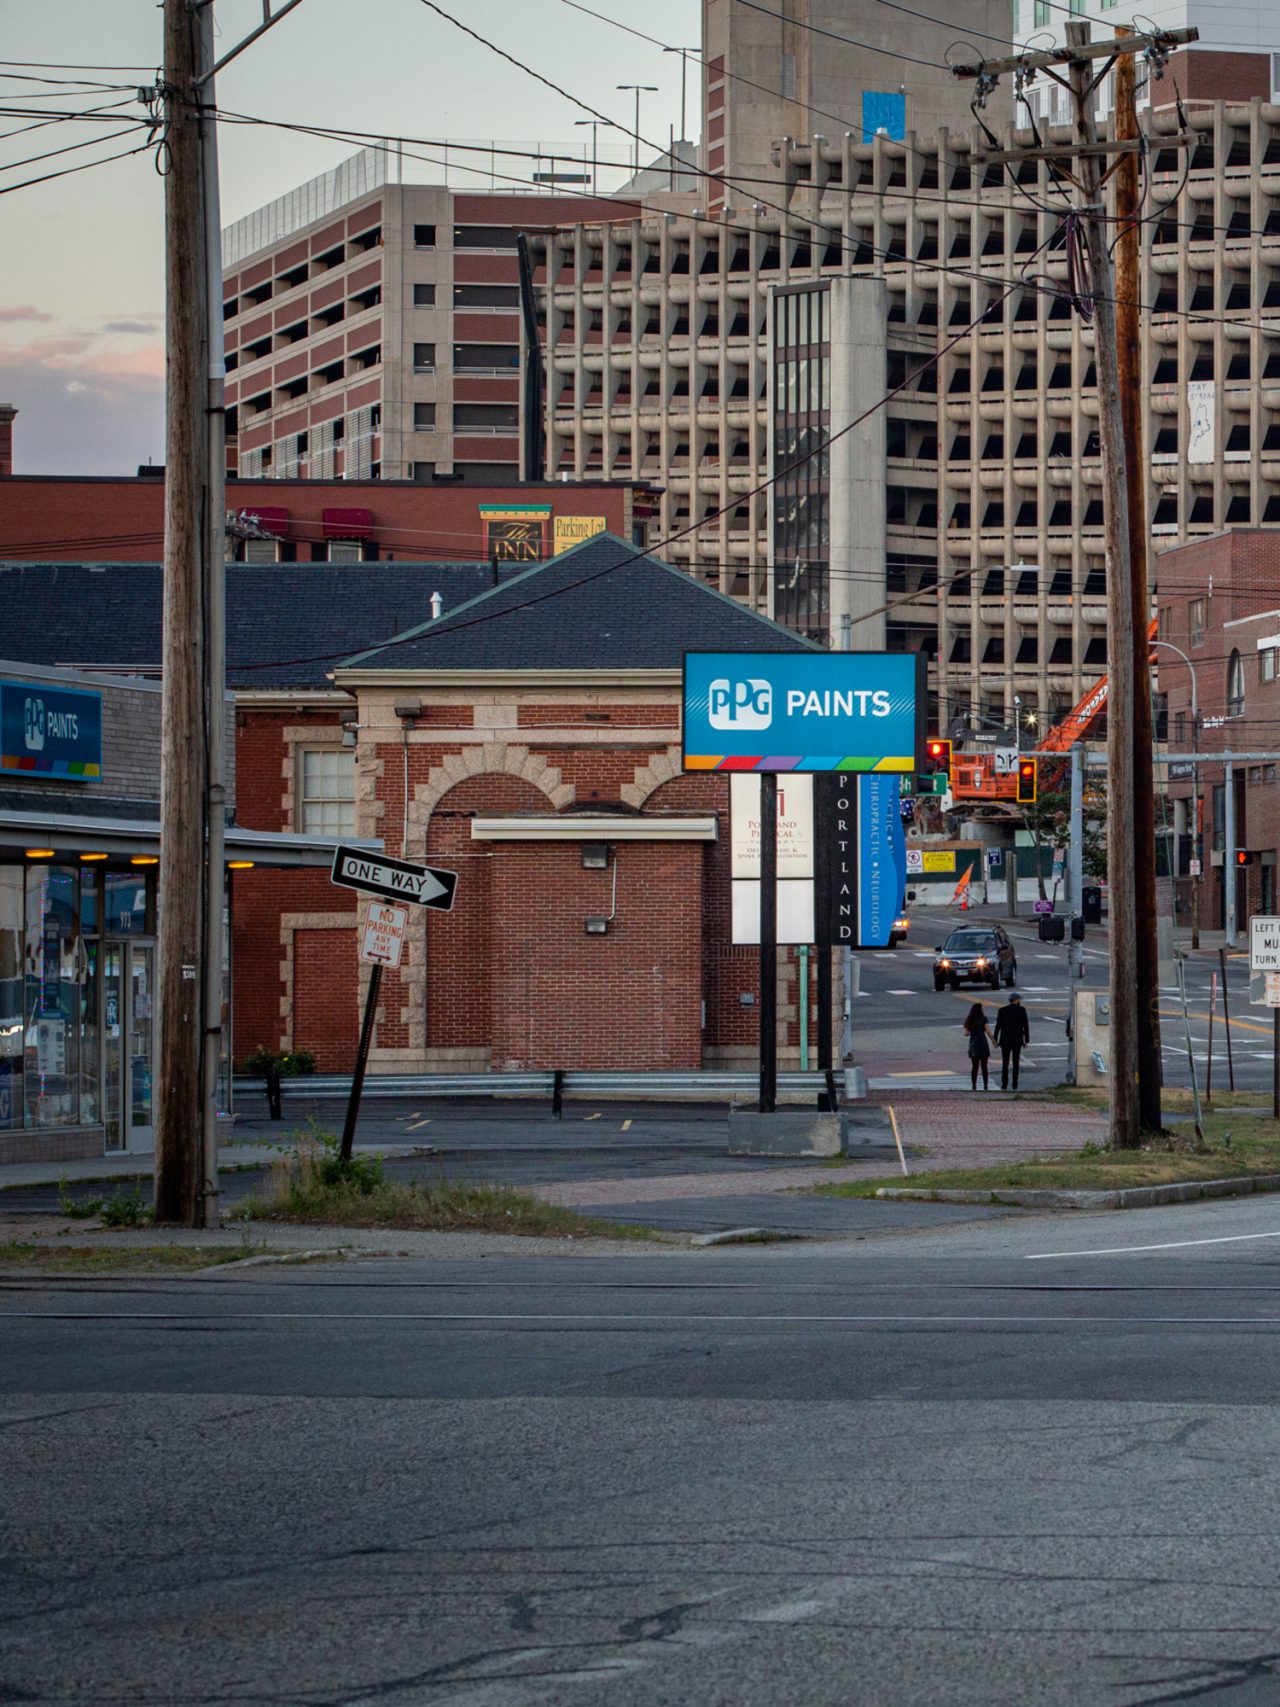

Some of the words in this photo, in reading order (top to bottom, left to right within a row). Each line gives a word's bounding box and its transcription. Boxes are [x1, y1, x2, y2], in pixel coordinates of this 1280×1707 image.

[499, 521, 539, 540] The
[556, 518, 588, 538] Parking
[495, 541, 539, 561] INN
[710, 679, 770, 721] PPG
[787, 690, 891, 717] PAINTS
[47, 711, 79, 740] PAINTS
[748, 821, 797, 829] POAND
[837, 775, 852, 938] PORTLAND
[347, 860, 382, 882] ONE
[391, 871, 427, 893] WAY
[871, 870, 881, 940] NEUROLOGY
[379, 911, 394, 923] NO
[367, 920, 402, 939] PARKING
[1255, 924, 1275, 933] LEFT
[373, 942, 391, 954] TIME
[375, 935, 391, 945] ANY
[1255, 955, 1277, 964] TURN
